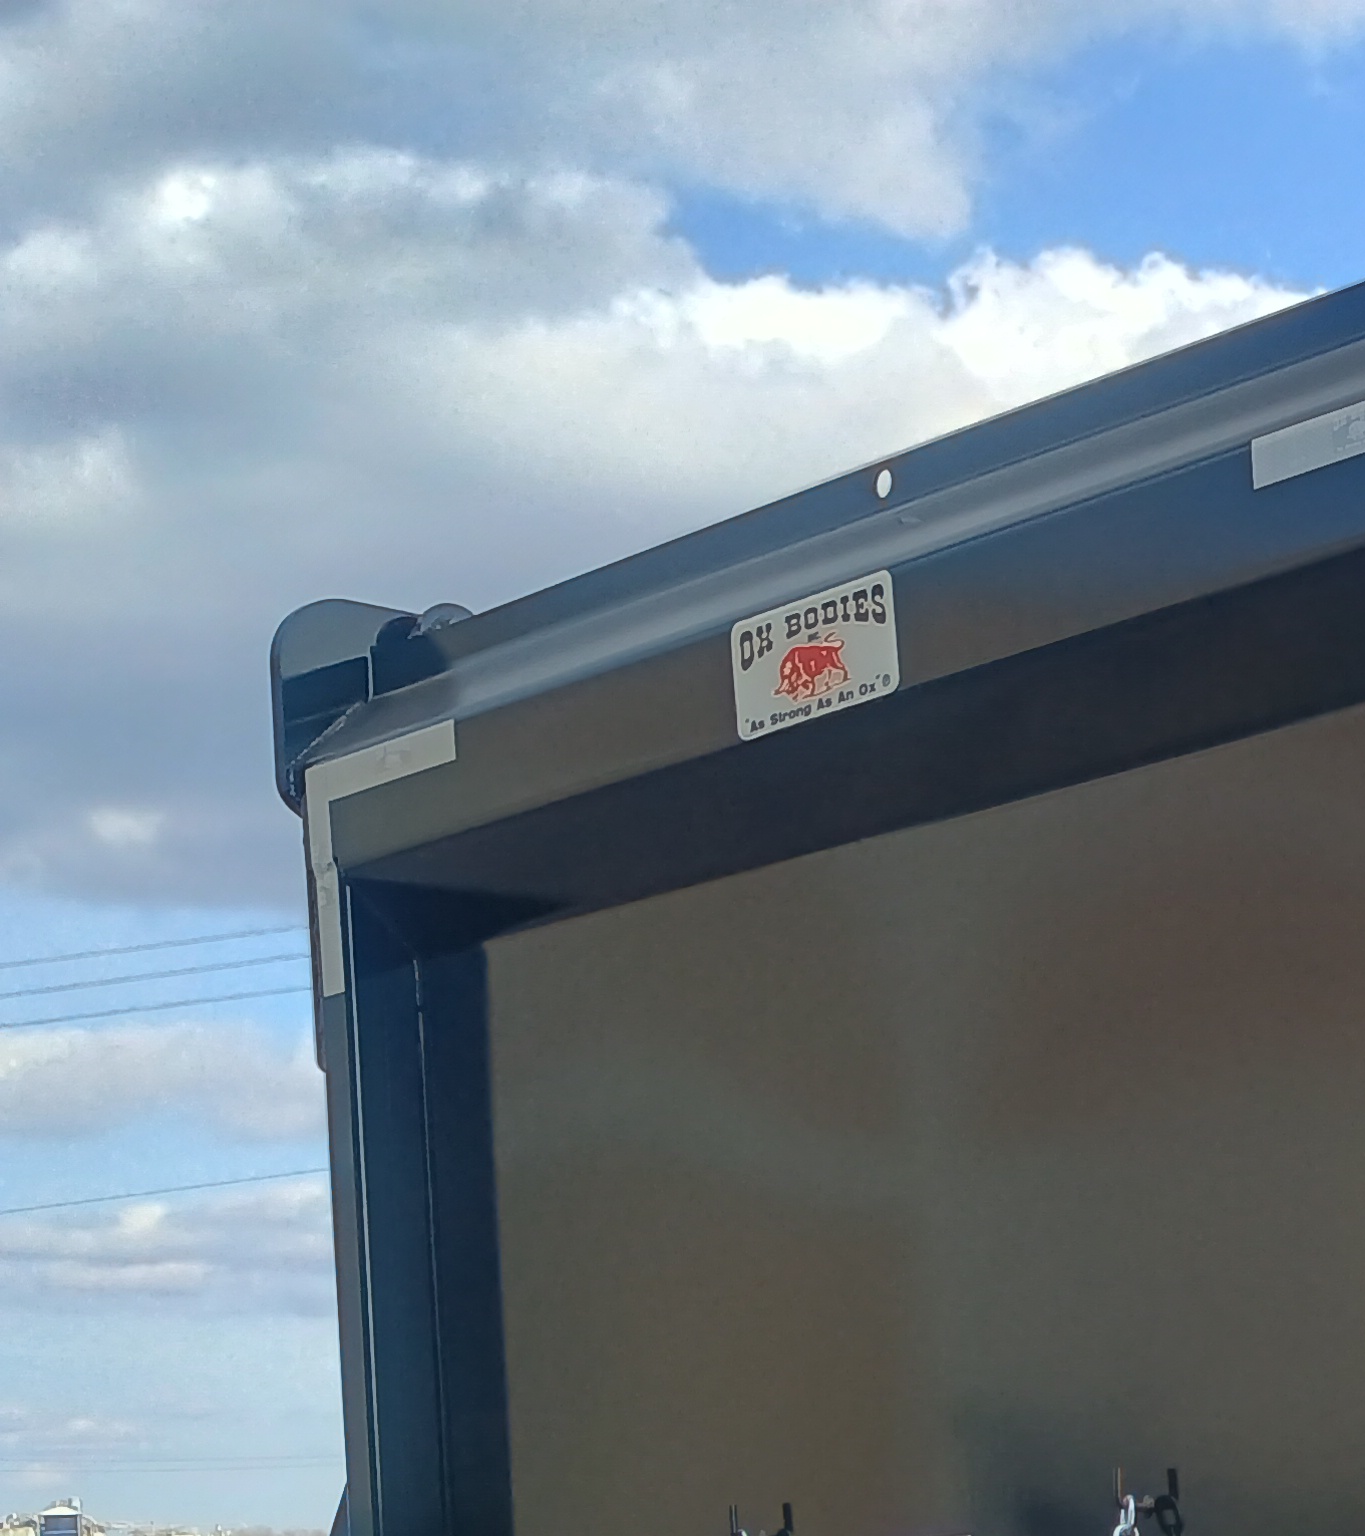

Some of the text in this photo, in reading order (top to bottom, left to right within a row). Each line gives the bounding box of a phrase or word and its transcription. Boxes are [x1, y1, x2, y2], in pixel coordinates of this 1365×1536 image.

[739, 583, 887, 672] OX BODIES
[769, 703, 812, 727] Strong
[816, 696, 833, 711] As
[838, 691, 855, 704] An
